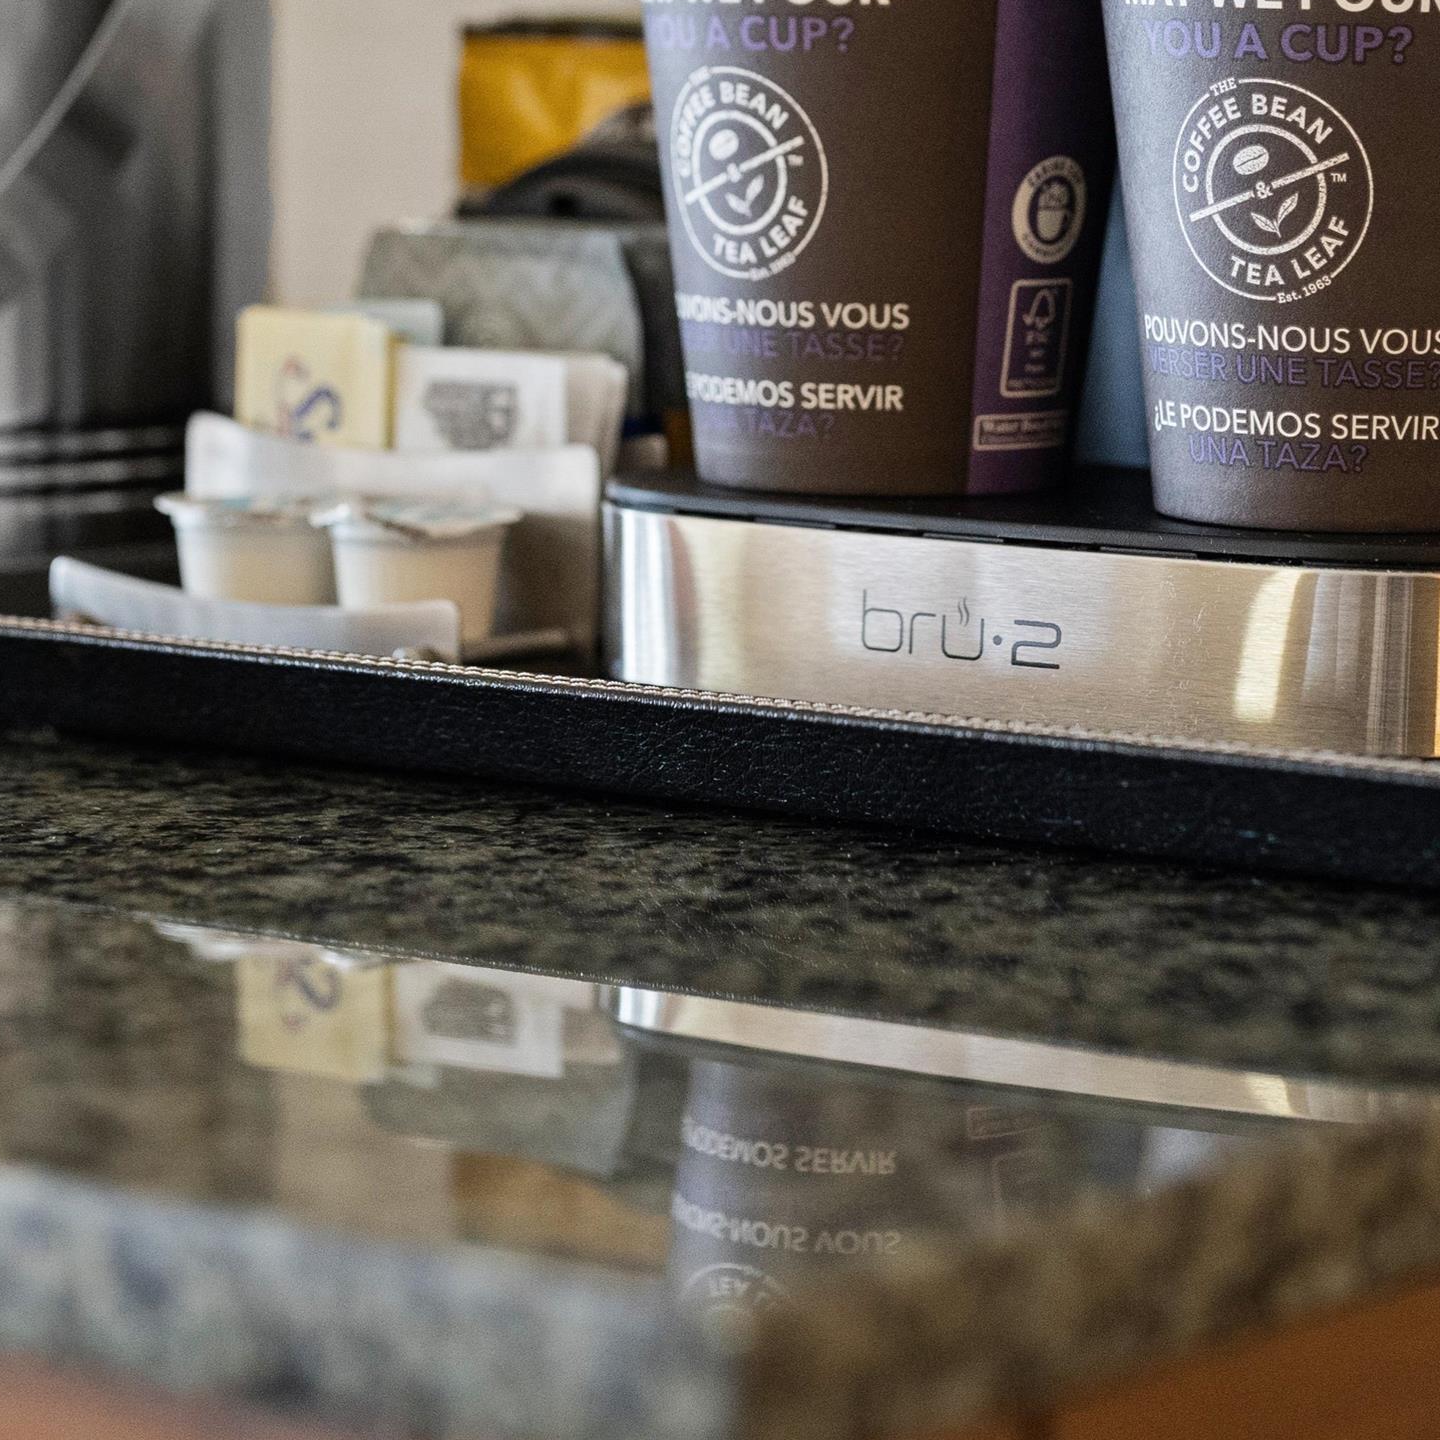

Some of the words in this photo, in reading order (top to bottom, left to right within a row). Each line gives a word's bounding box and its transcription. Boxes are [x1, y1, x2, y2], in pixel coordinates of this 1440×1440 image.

[645, 14, 696, 51] OU
[706, 14, 732, 51] A
[738, 15, 856, 54] CUP?
[1140, 18, 1223, 59] YOU
[1231, 21, 1269, 62] A
[1278, 22, 1416, 65] CUP?
[719, 80, 790, 131] BEAN
[1210, 76, 1238, 97] THE
[1181, 96, 1242, 193] COFFEE
[1250, 92, 1334, 145] BEAN
[1254, 180, 1274, 200] &
[713, 232, 758, 265] TEA
[759, 194, 809, 258] LEAF
[1230, 254, 1286, 287] TEA
[1289, 215, 1350, 280] LEAF
[1276, 290, 1303, 305] Est.
[1301, 274, 1333, 299] 1963
[819, 302, 911, 331] VOUS
[1144, 313, 1351, 355] POUVONS-NOUS
[1147, 343, 1228, 381] VERSER
[1235, 352, 1308, 387] UNE
[799, 381, 905, 411] SERVIR
[1179, 402, 1322, 439] PODEMOS
[1331, 413, 1440, 442] SERVIR
[1188, 435, 1251, 468] UNA
[1257, 440, 1369, 473] TAZA?
